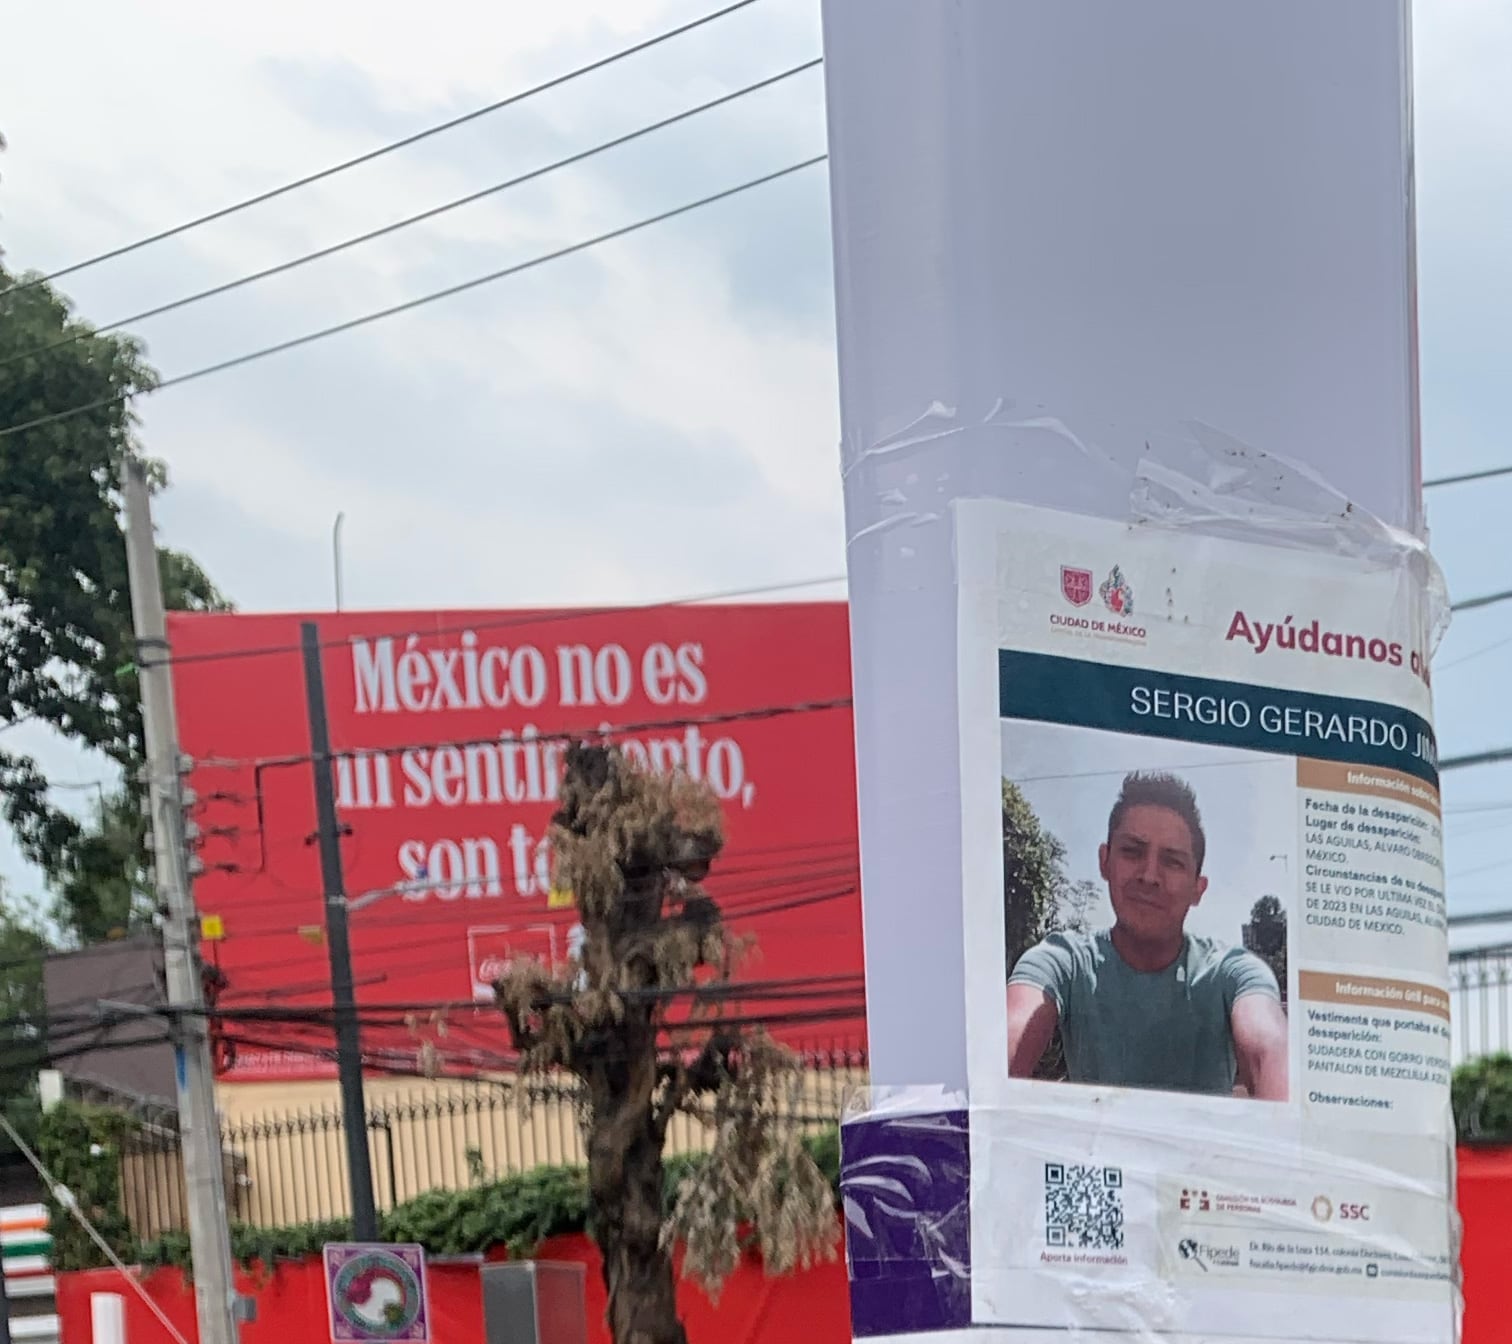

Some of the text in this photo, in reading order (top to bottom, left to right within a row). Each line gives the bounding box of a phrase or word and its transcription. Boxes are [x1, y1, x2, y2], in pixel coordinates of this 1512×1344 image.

[1050, 614, 1088, 629] CIUDAD
[1092, 622, 1105, 632] DE
[1108, 623, 1146, 638] MÉXICO
[1226, 610, 1403, 666] Ayúdanos
[349, 630, 707, 714] México no es
[1131, 687, 1250, 729] SERGIO
[1259, 705, 1408, 751] GERARDO
[1305, 799, 1339, 814] Fecha
[1342, 804, 1356, 814] de
[1359, 806, 1369, 816] la
[1305, 816, 1337, 830] Lugar
[1341, 819, 1353, 830] de
[399, 834, 500, 901] son
[1308, 1027, 1382, 1042] desaparición:
[1309, 1092, 1393, 1109] Observaciones:
[1339, 1203, 1370, 1221] SSC
[1040, 1251, 1128, 1266] Aporta información
